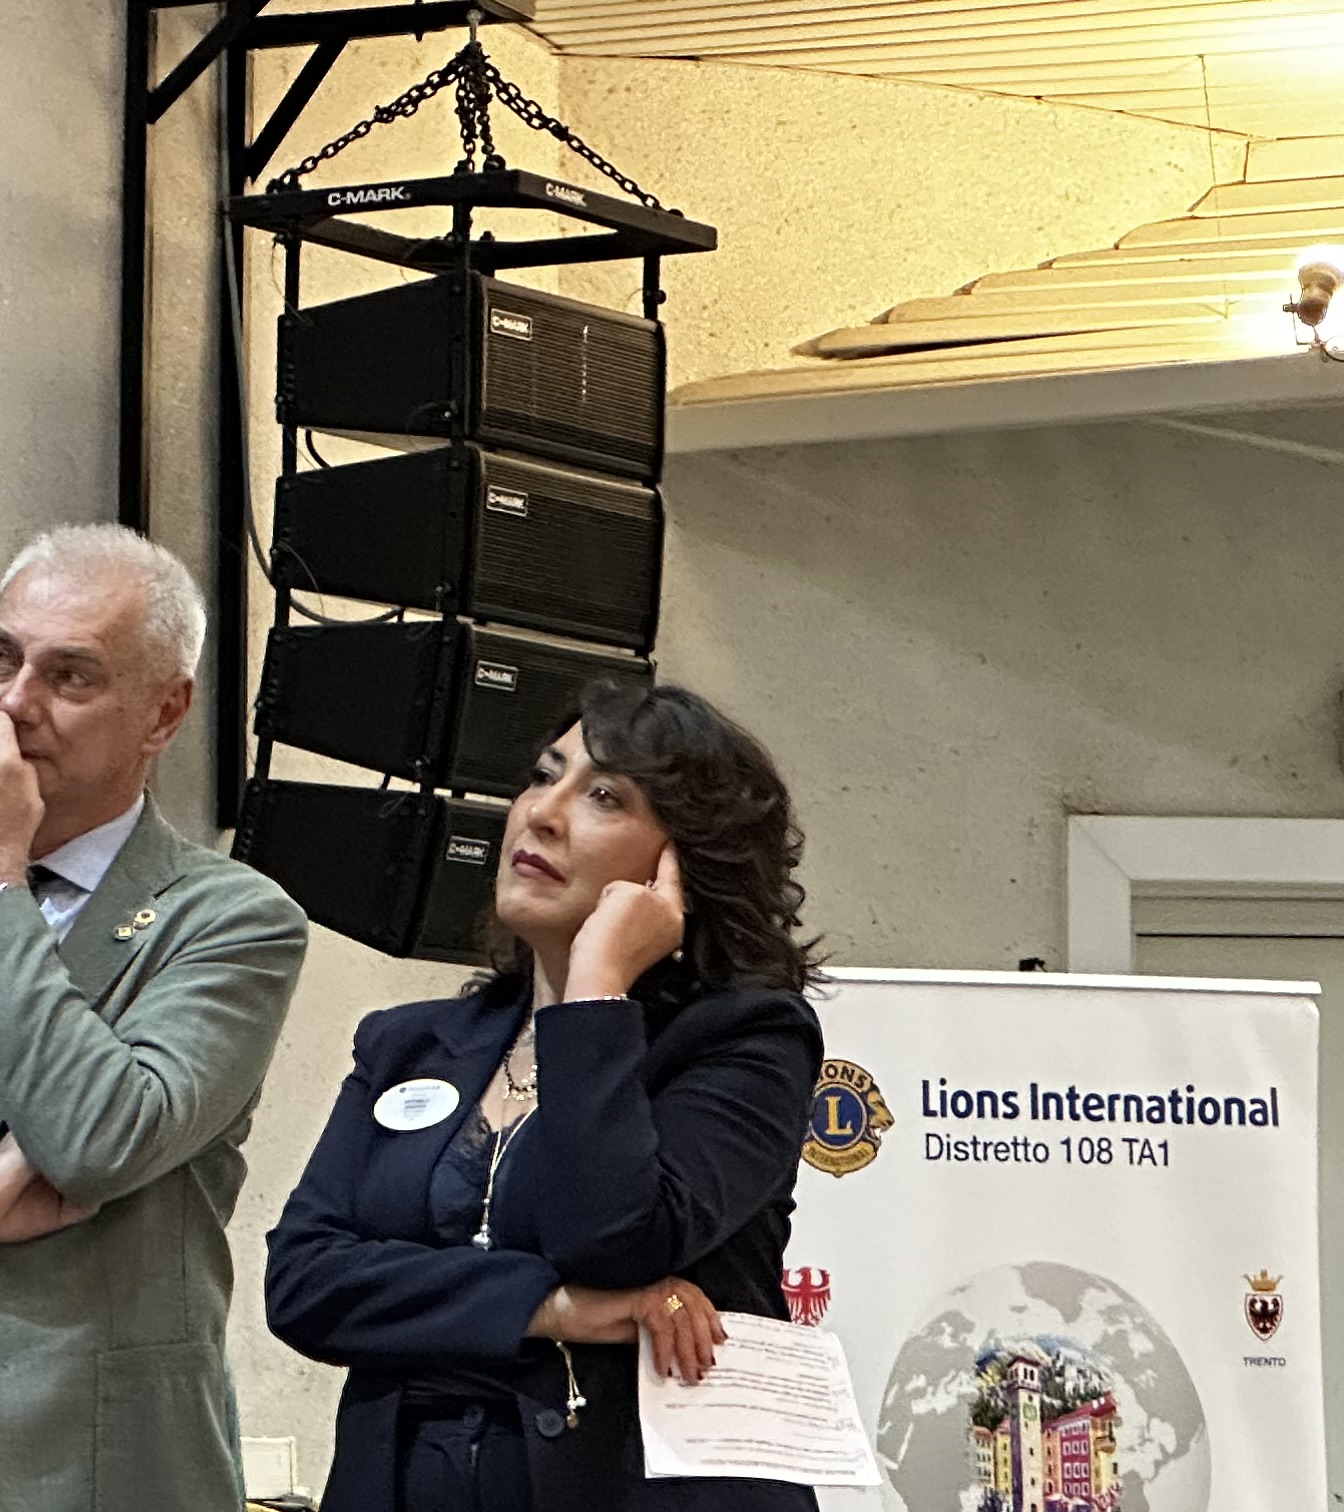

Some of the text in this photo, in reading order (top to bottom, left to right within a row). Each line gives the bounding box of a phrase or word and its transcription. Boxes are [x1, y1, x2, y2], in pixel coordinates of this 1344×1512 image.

[327, 186, 406, 207] C-MARK
[824, 1095, 853, 1136] L
[921, 1077, 1280, 1127] Lions International
[924, 1133, 1170, 1167] Distretto 108 TA1
[1243, 1356, 1287, 1367] TRENTO
